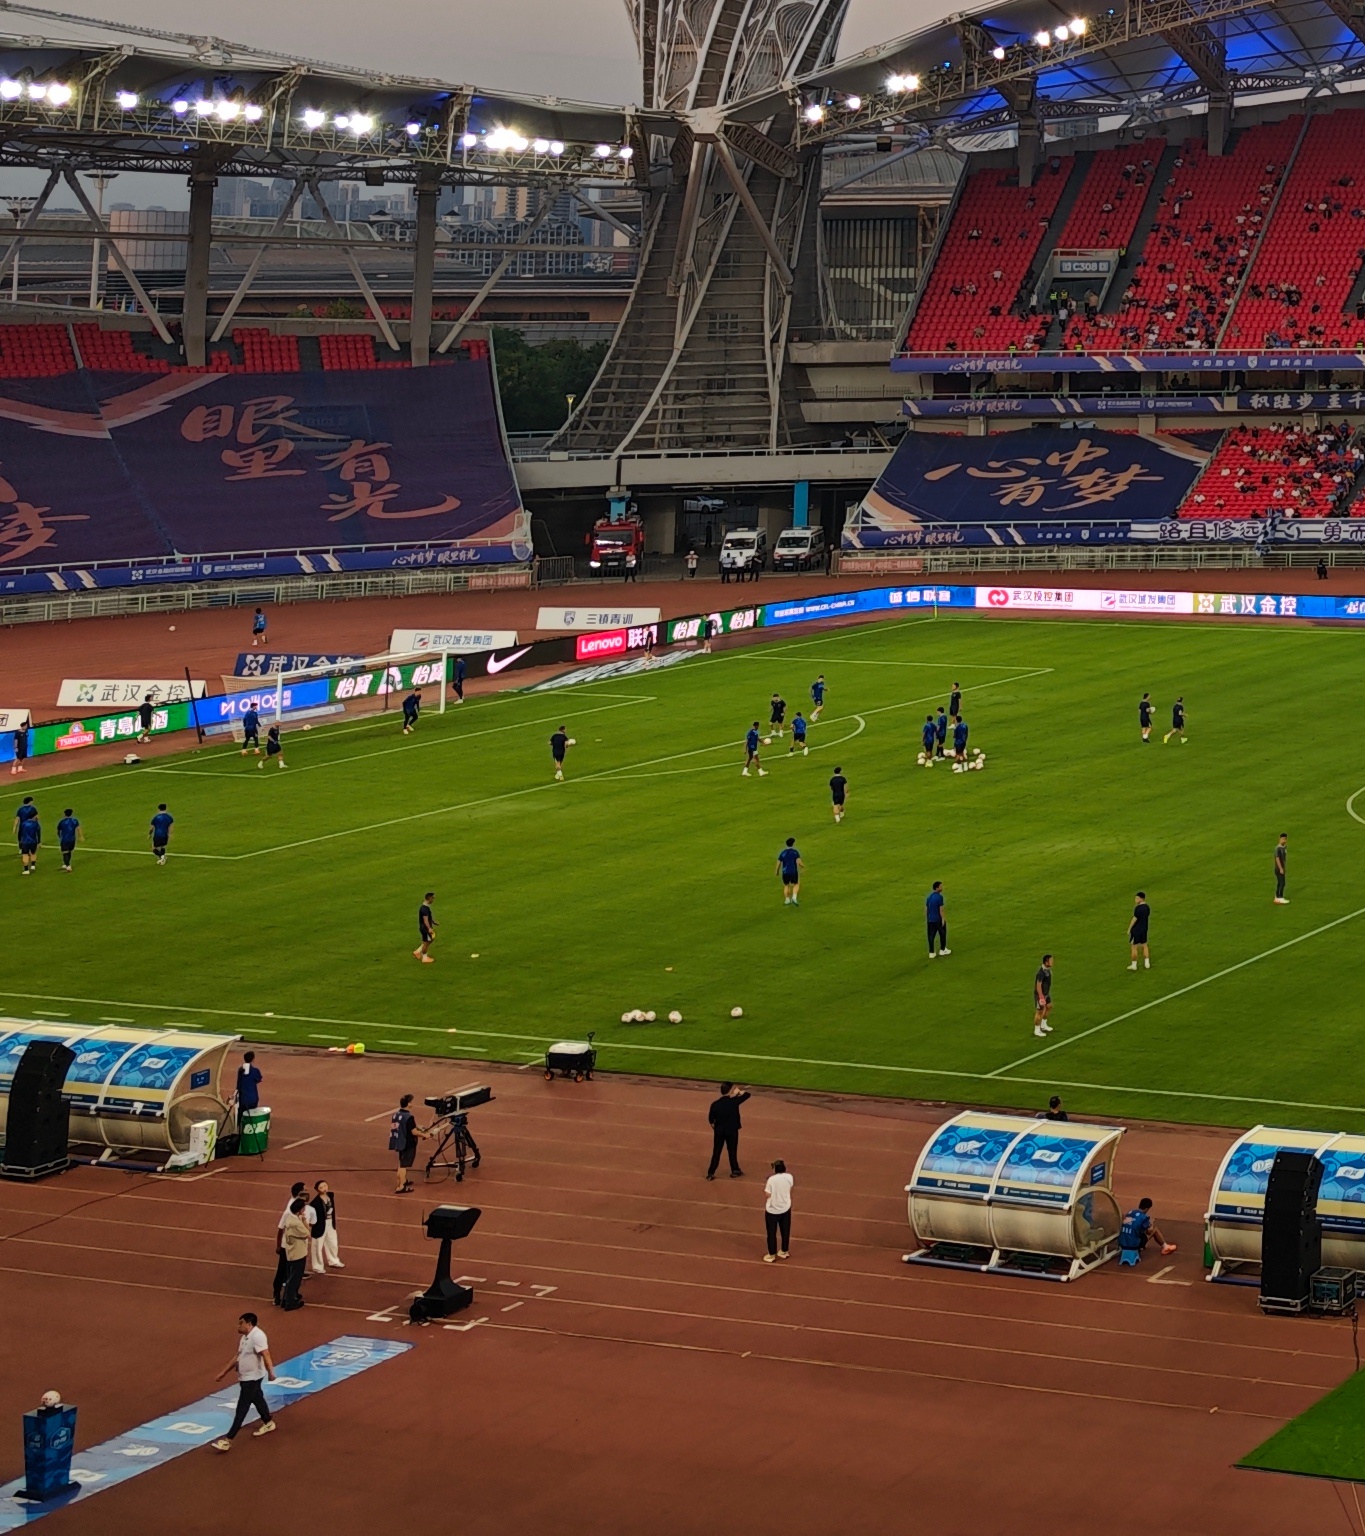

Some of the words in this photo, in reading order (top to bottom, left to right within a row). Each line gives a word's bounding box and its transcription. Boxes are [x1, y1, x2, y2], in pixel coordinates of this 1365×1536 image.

[949, 358, 985, 371] 心中有梦
[986, 358, 1022, 371] 眼里有光
[949, 399, 985, 413] 心中有梦
[986, 400, 1022, 413] 眼里有光
[884, 531, 923, 545] 心中有梦
[924, 530, 965, 544] 眼里有光
[392, 549, 436, 566] 心中有梦
[437, 547, 481, 563] 眼里有光
[1220, 595, 1297, 615] 武汉金控
[586, 613, 633, 624] 三镇青训
[432, 633, 493, 646] 武汉城发集团
[581, 635, 623, 654] Lenovo
[100, 683, 187, 703] 武汉金控
[334, 673, 374, 699] 怡寶
